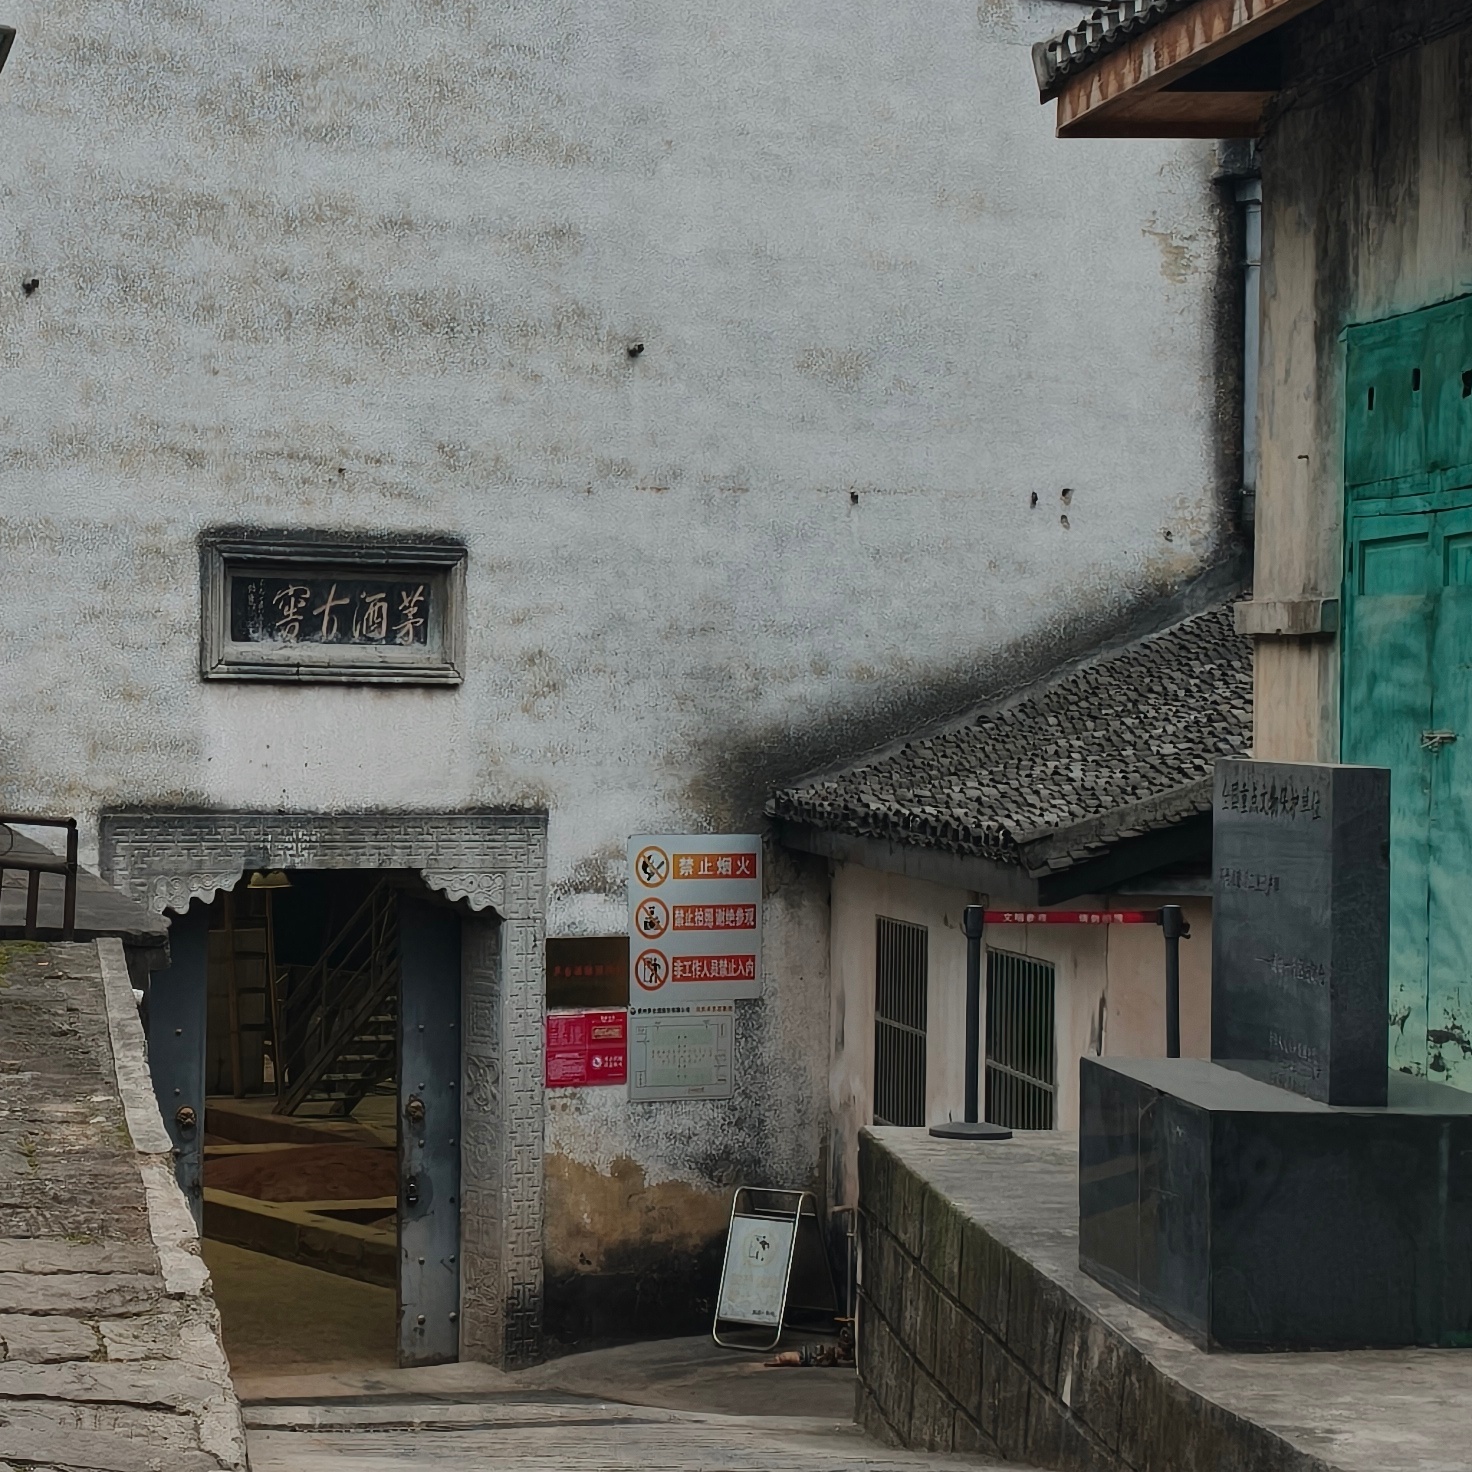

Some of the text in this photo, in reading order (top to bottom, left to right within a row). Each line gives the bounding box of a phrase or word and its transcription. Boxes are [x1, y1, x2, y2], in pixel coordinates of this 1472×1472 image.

[272, 582, 426, 646] 茅酒古窖
[678, 856, 751, 877] 禁止烟火
[673, 958, 754, 979] 非工作人员禁止入内
